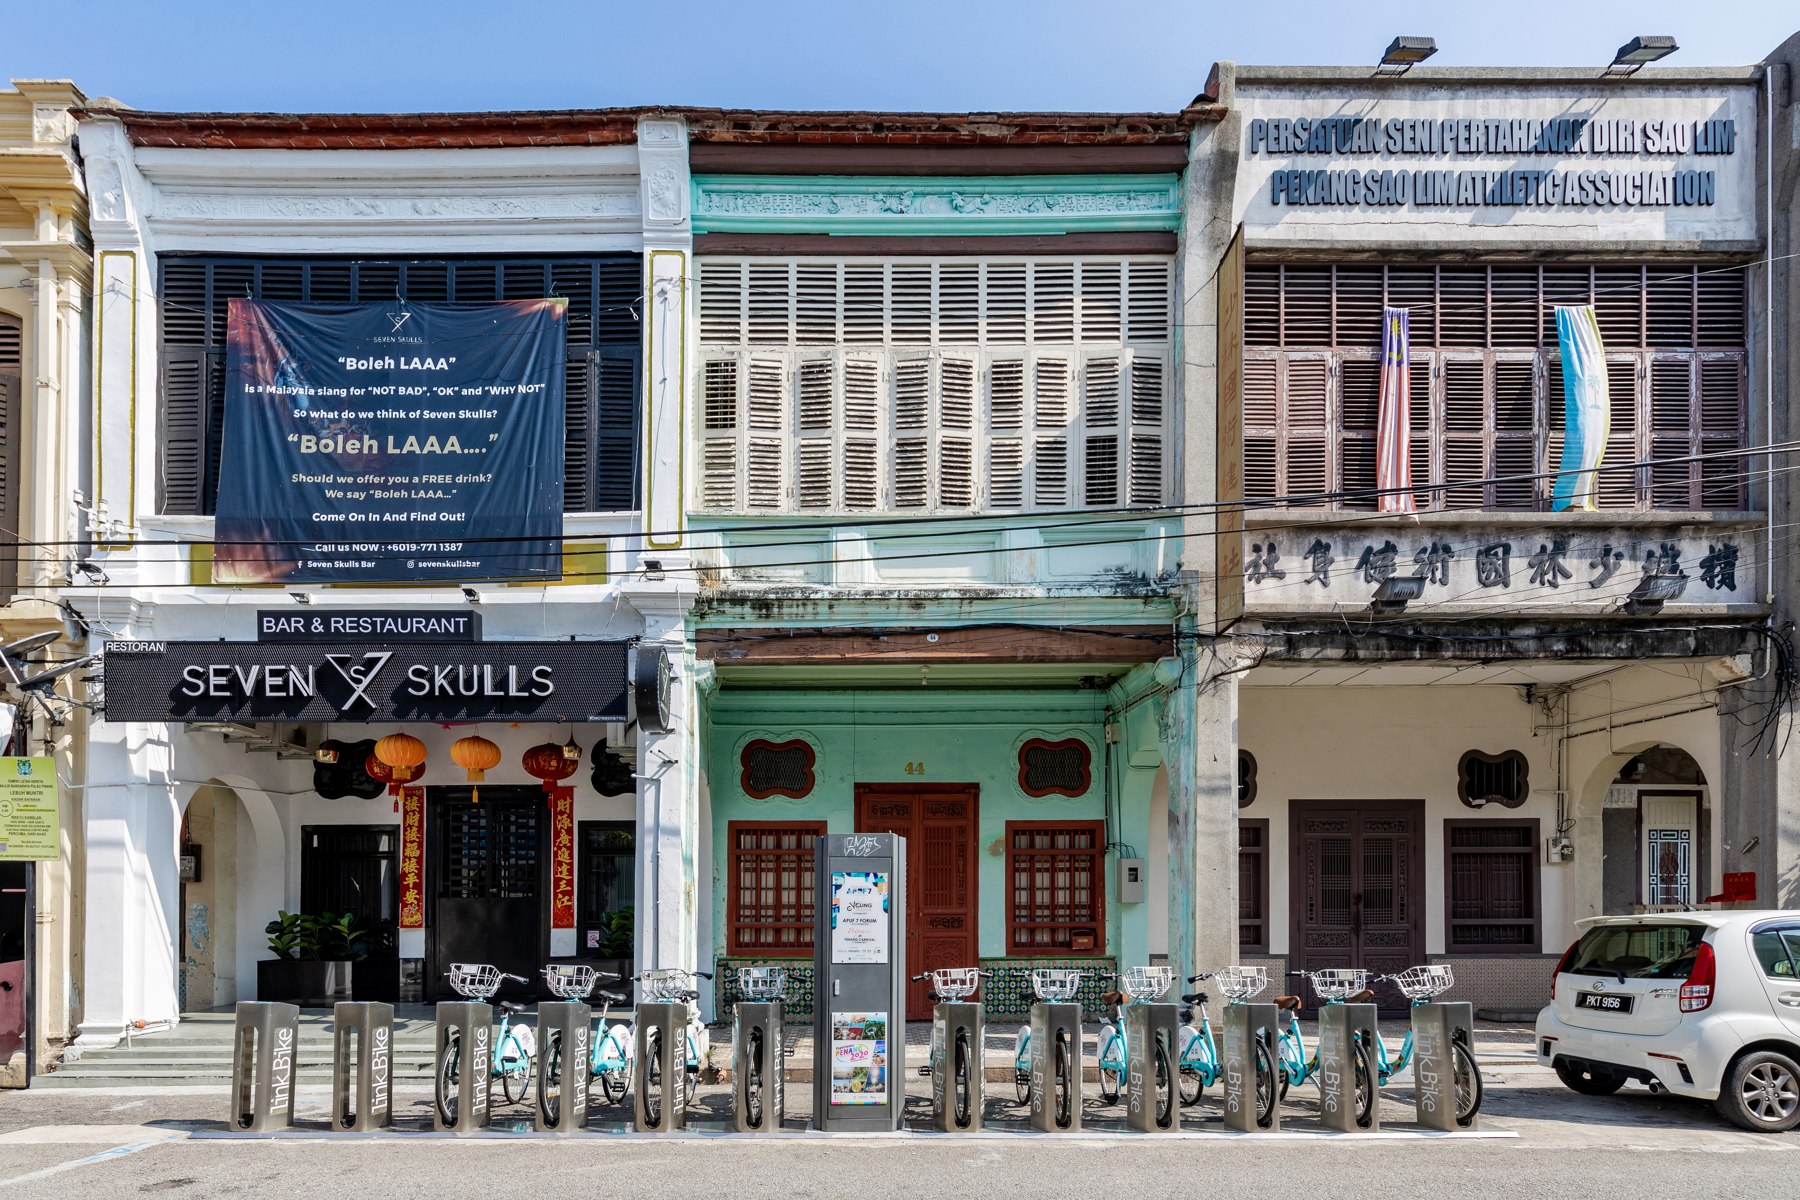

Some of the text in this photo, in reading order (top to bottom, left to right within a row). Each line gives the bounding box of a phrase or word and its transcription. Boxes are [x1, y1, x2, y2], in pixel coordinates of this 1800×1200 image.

[1250, 118, 1735, 154] PERSATUAN SENI PERTAHANAN DIRI SAO LIM
[1271, 169, 1715, 206] PENANG SAO LIM ATHLETIC ASSOCIATION
[257, 385, 263, 393] a
[266, 385, 315, 396] Malaysia
[318, 386, 347, 398] slang
[350, 386, 366, 396] for
[461, 386, 482, 396] and
[293, 408, 498, 419] So what do we think of Seven Skulls?
[291, 473, 493, 486] Should we offer you a FREE drink?
[324, 489, 344, 498] We
[346, 491, 366, 500] say
[312, 512, 465, 522] Come On In And Find Out!
[315, 543, 335, 552] Call
[337, 544, 350, 552] us
[352, 543, 380, 552] NOW
[386, 543, 437, 552] +6019-771
[439, 542, 463, 552] 1387
[307, 560, 332, 568] Seven
[334, 560, 359, 568] Skulls
[361, 560, 376, 568] Bar
[418, 560, 481, 568] sevenskullsbar
[263, 617, 468, 633] BAR & RESTAURANT
[106, 642, 164, 652] RESTORAN
[182, 665, 314, 697] SEVEN
[407, 664, 554, 697] SKULLS
[904, 762, 926, 775] 44
[401, 796, 421, 905] 接財接福接平安
[1586, 995, 1621, 1009] PKT 9156
[836, 1043, 863, 1057] PENANG
[850, 1050, 869, 1061] 2020
[270, 1028, 293, 1113] Link Bike
[372, 1028, 388, 1113] Link Bike
[473, 1028, 488, 1113] Link Bike
[574, 1028, 587, 1113] Link Bike
[674, 1028, 684, 1114] Link Bike
[1033, 1071, 1044, 1112] Bike
[1130, 1071, 1143, 1113] Bike
[1324, 1071, 1341, 1112] Bike
[1420, 1071, 1438, 1112] Bike
